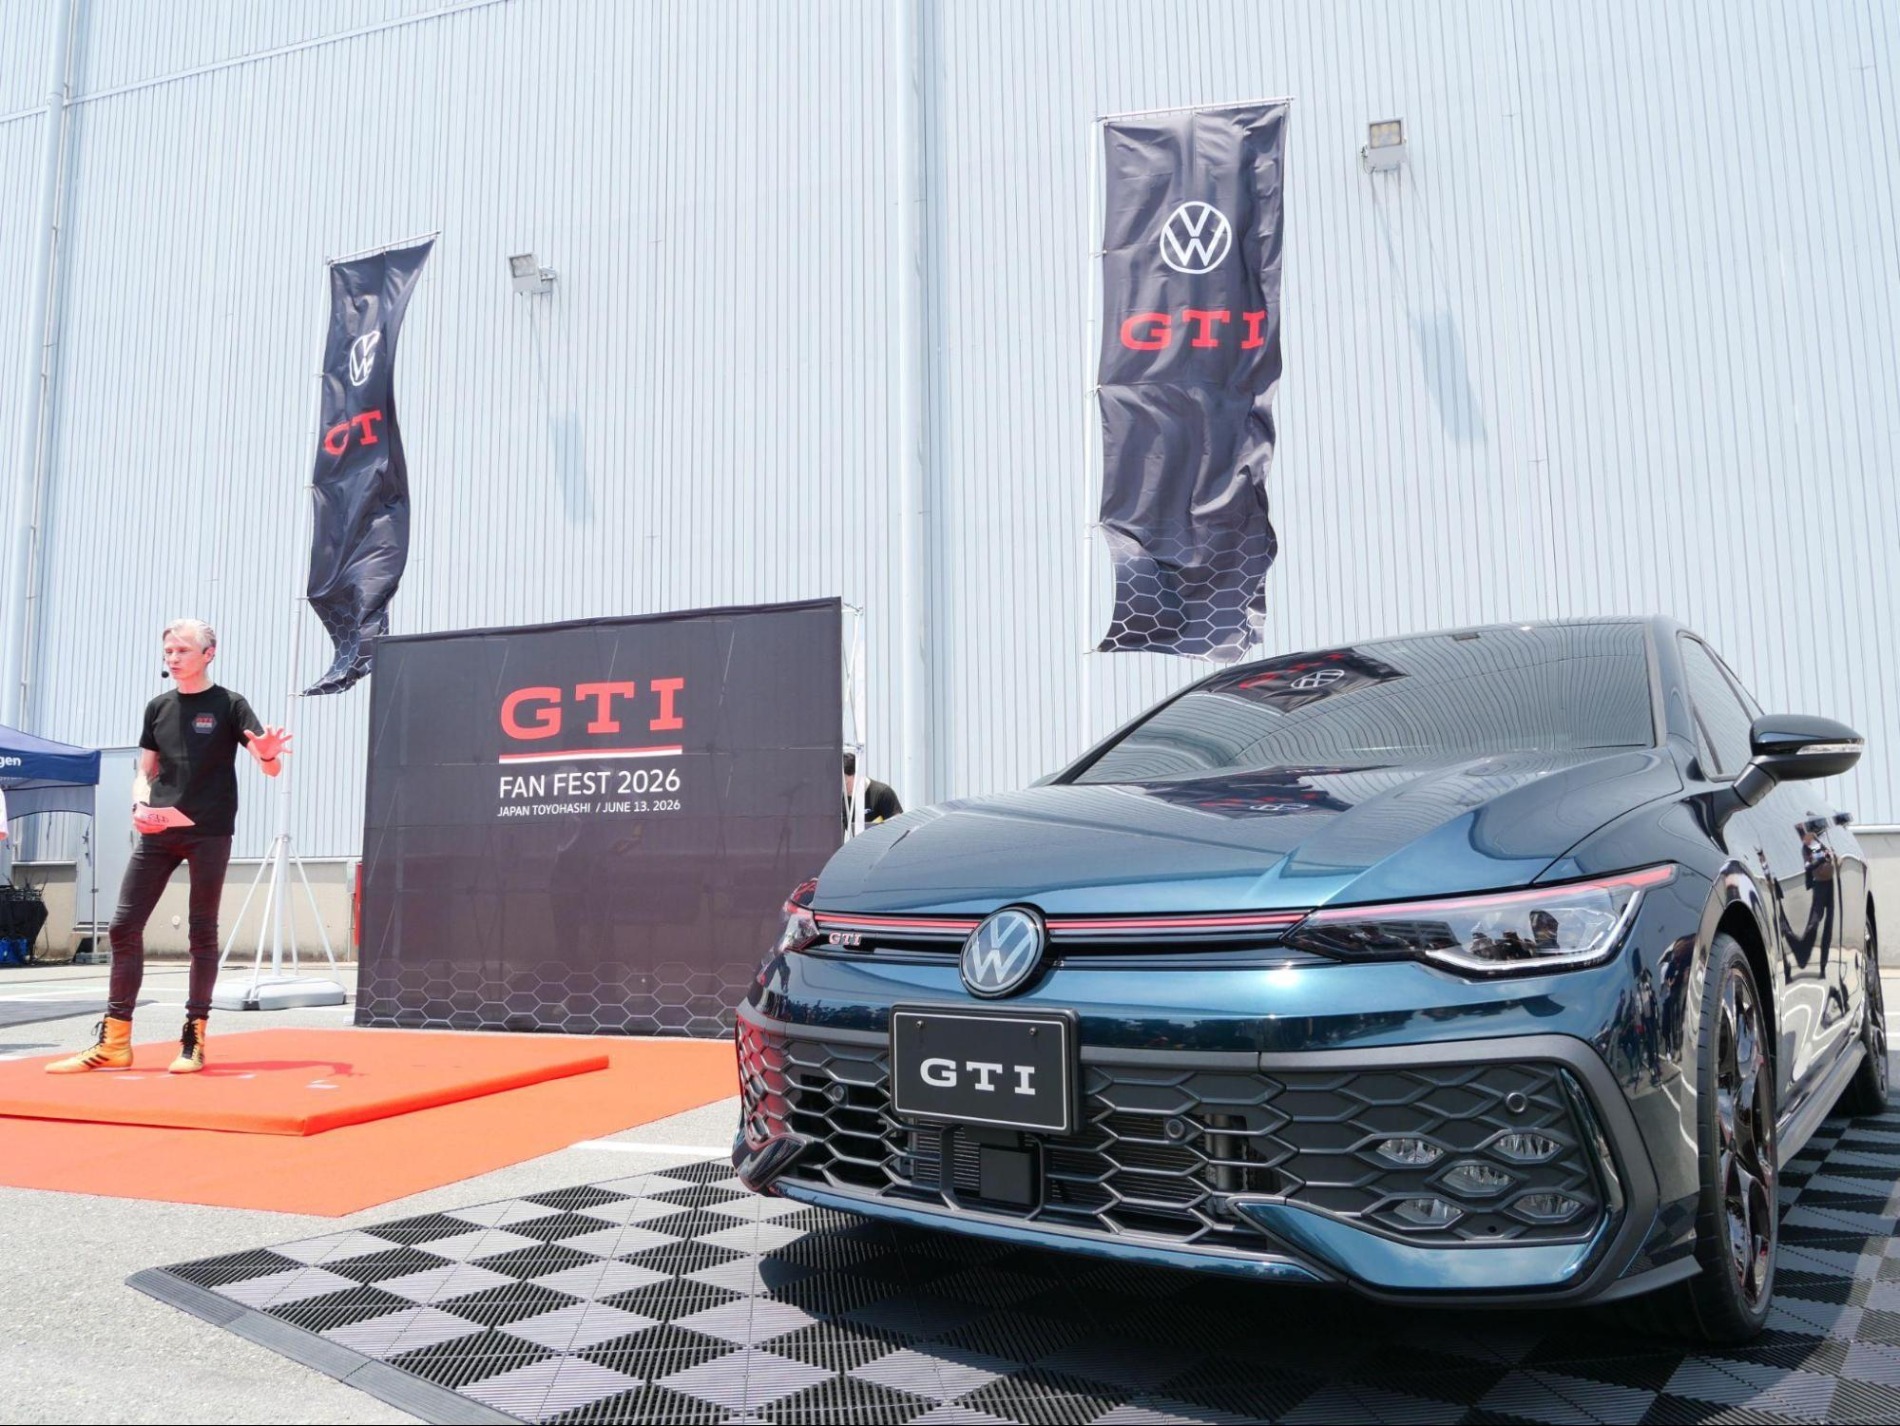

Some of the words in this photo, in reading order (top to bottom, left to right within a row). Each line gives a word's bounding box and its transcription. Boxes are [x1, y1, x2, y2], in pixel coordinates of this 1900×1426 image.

[1161, 202, 1231, 273] VW
[1120, 309, 1266, 351] GTI
[501, 677, 684, 740] GTI
[500, 775, 545, 799] FAN
[553, 771, 611, 796] FEST
[617, 768, 681, 794] 2026
[497, 805, 529, 817] JAPAN
[532, 802, 591, 816] TOYOHASHI
[603, 801, 631, 813] JUNE
[634, 800, 650, 812] 13.
[653, 799, 681, 812] 2026
[829, 932, 861, 946] GTI
[962, 910, 1038, 992] VW
[920, 1058, 1036, 1095] GTI
